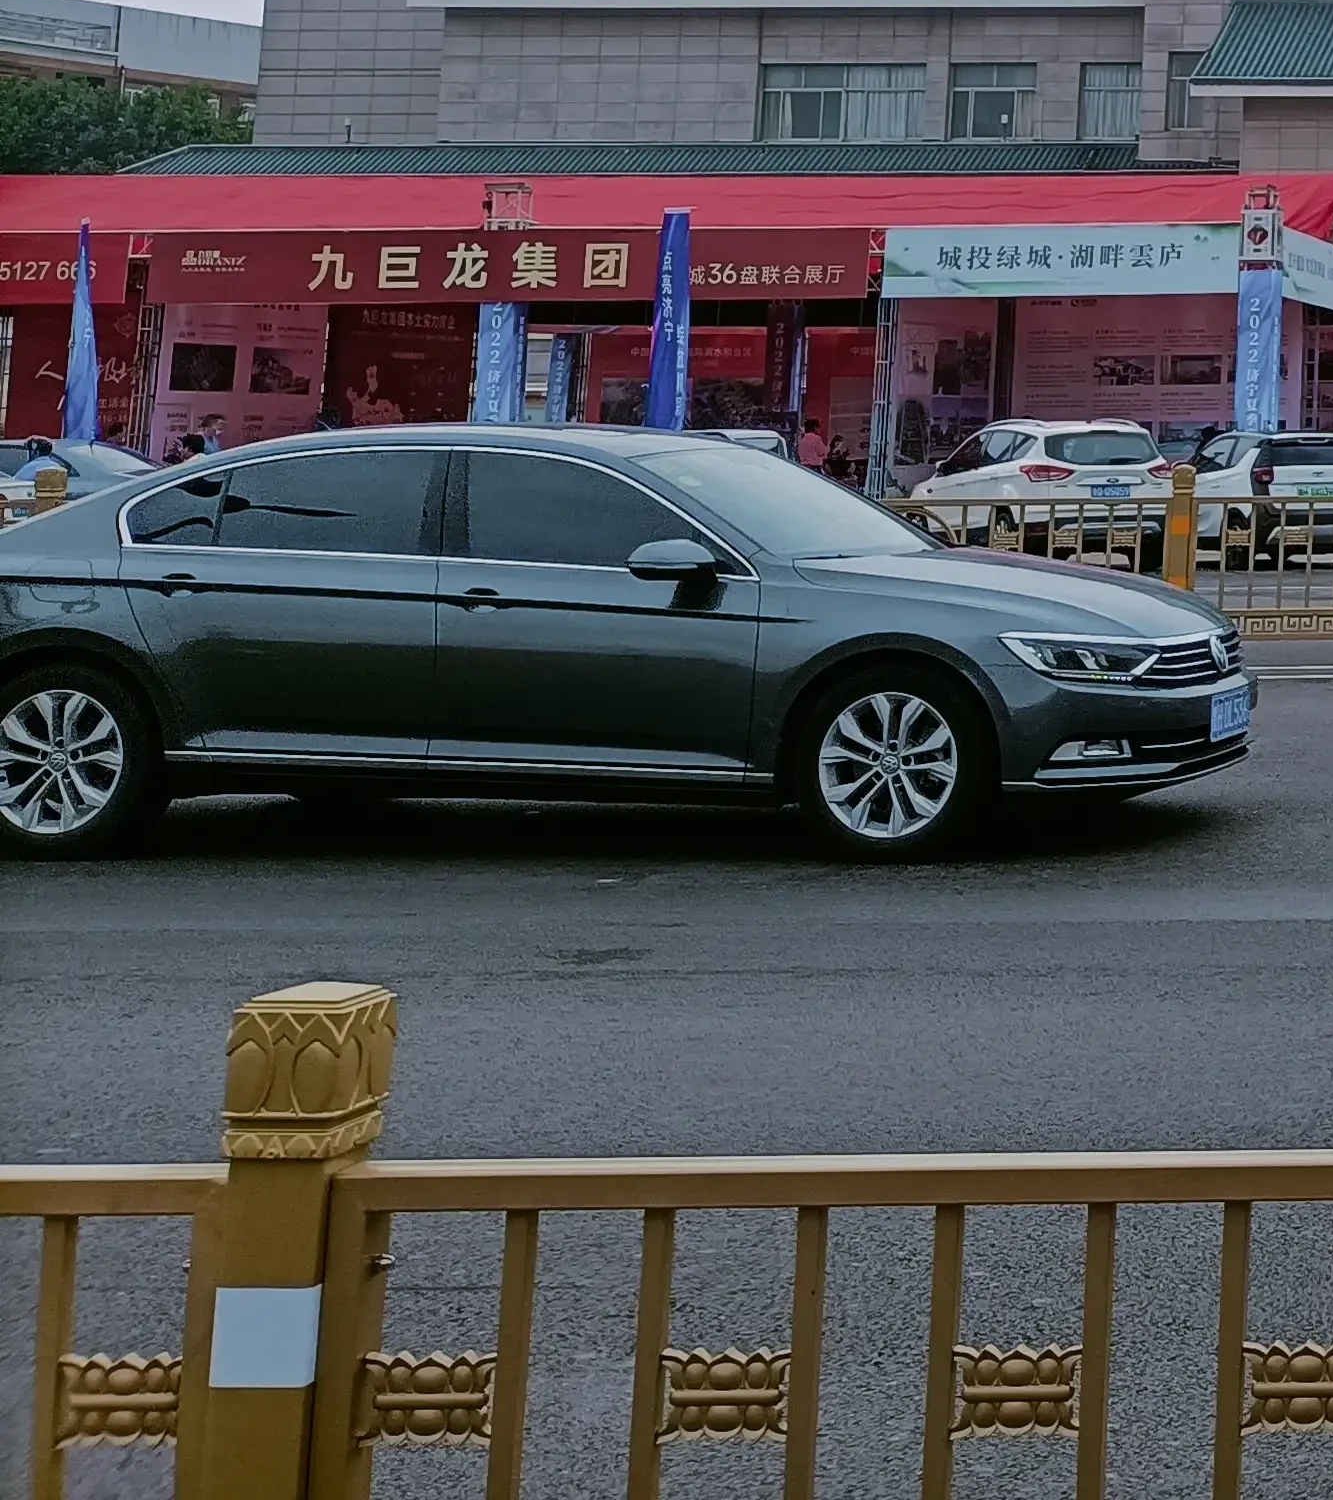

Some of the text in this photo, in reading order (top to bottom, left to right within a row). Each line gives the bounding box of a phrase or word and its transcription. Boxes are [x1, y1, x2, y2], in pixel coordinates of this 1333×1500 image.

[0, 261, 50, 281] 5127
[308, 241, 629, 291] 九巨龙集团
